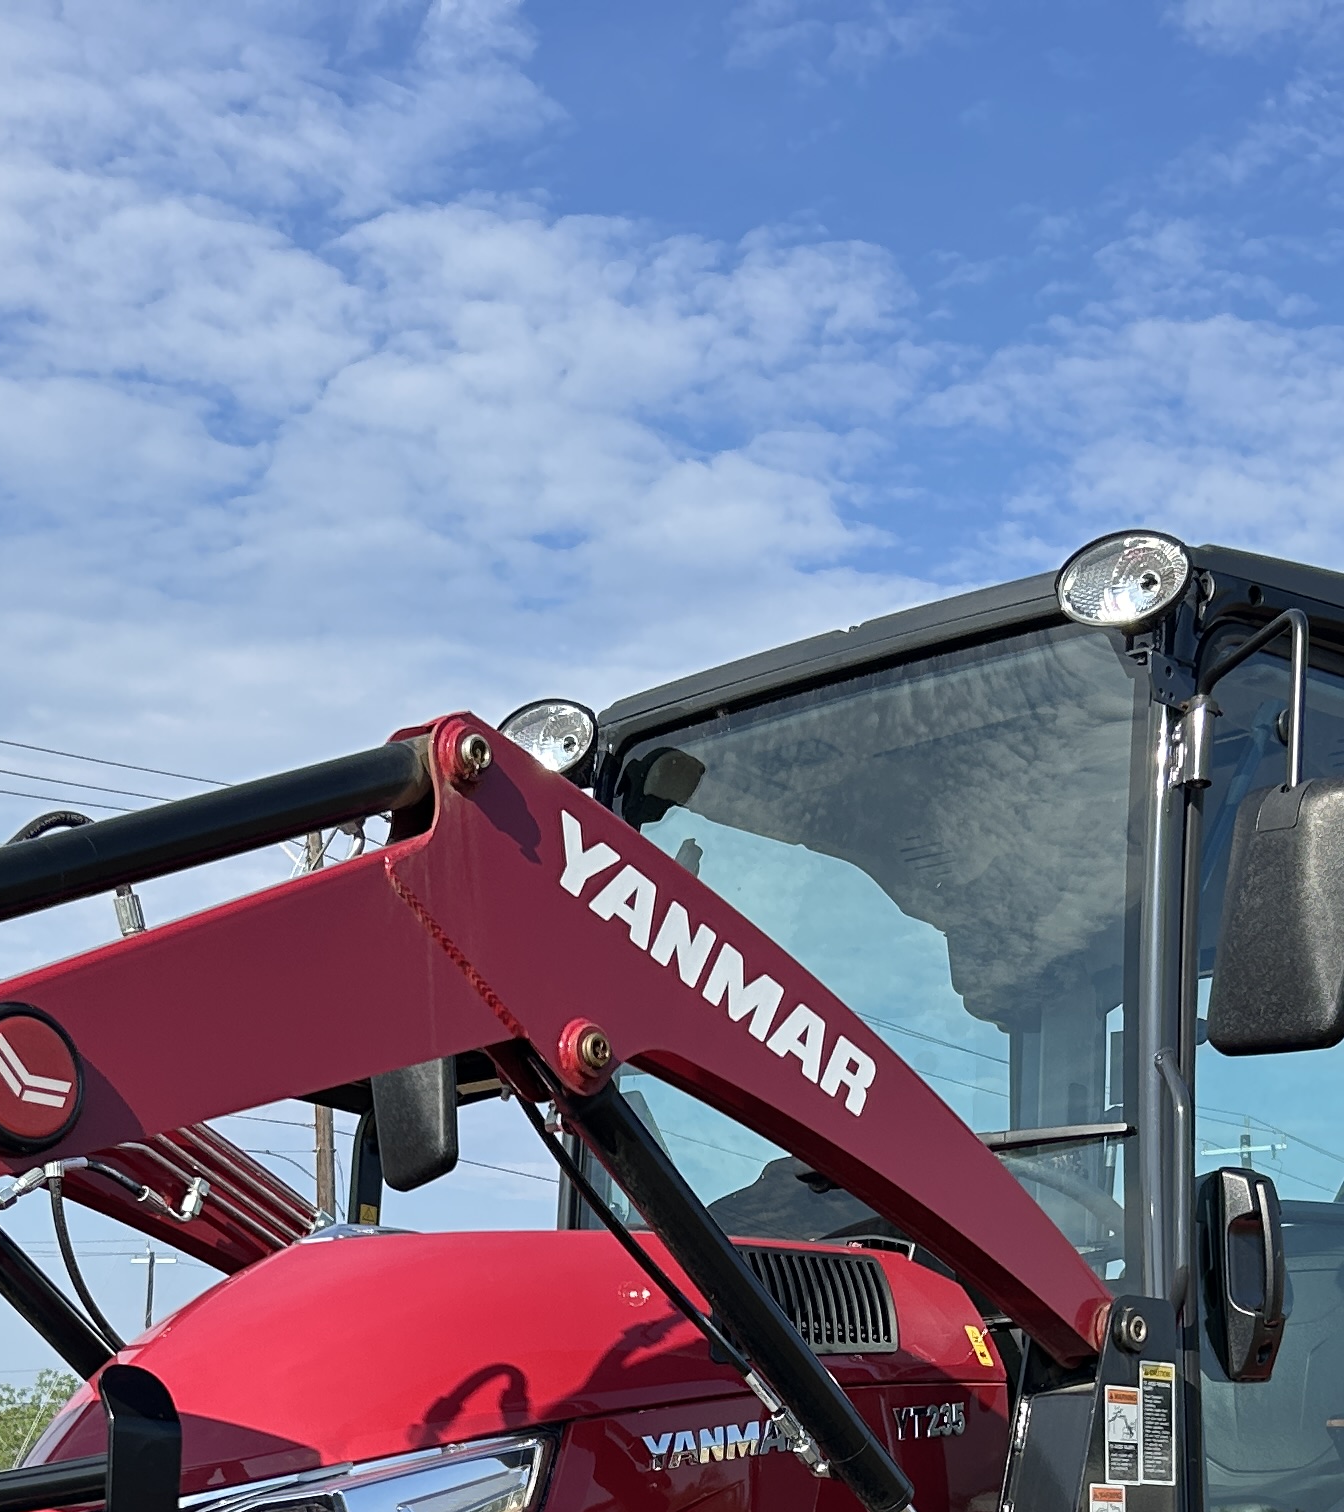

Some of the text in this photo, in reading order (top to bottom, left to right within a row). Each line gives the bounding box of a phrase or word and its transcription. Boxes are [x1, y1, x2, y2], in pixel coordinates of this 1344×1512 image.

[559, 809, 877, 1117] YANMAR
[641, 1419, 792, 1471] YANMA
[892, 1402, 966, 1441] YT235
